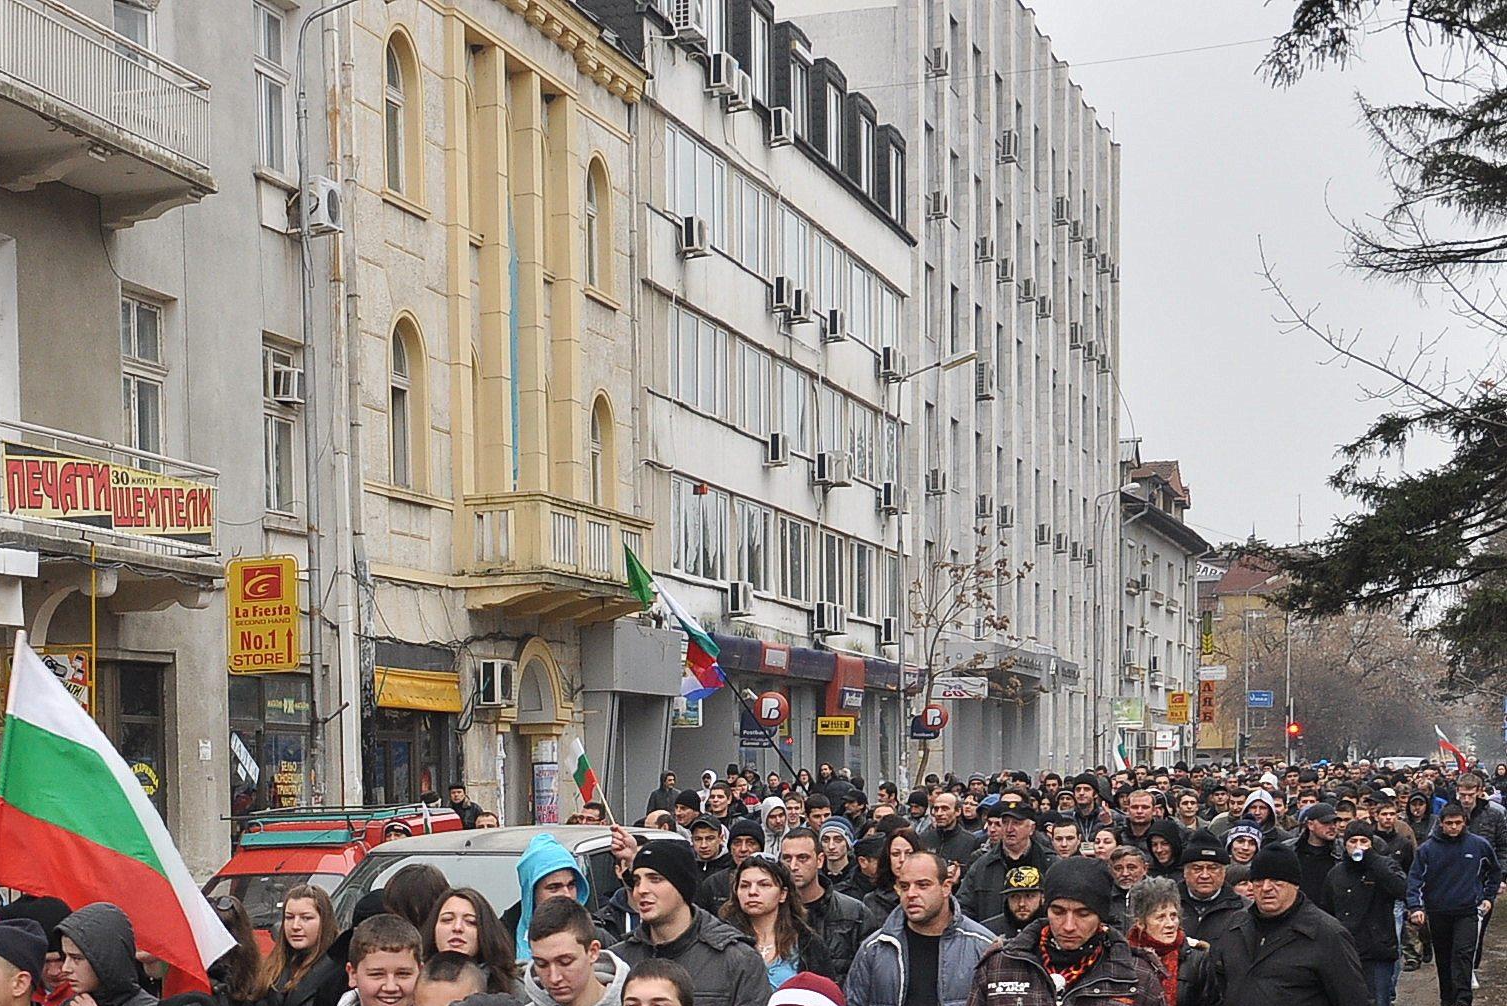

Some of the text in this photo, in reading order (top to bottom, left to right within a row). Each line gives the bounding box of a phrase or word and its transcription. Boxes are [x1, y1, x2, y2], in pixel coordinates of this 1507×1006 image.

[111, 470, 130, 486] 30
[5, 458, 112, 515] ПЕЧАТИ
[111, 486, 212, 532] ШЕМПЕЛИ
[235, 604, 291, 619] La Fiesta
[235, 617, 291, 627] SECOND HAND
[240, 629, 277, 651] No.1
[233, 652, 284, 667] STORE
